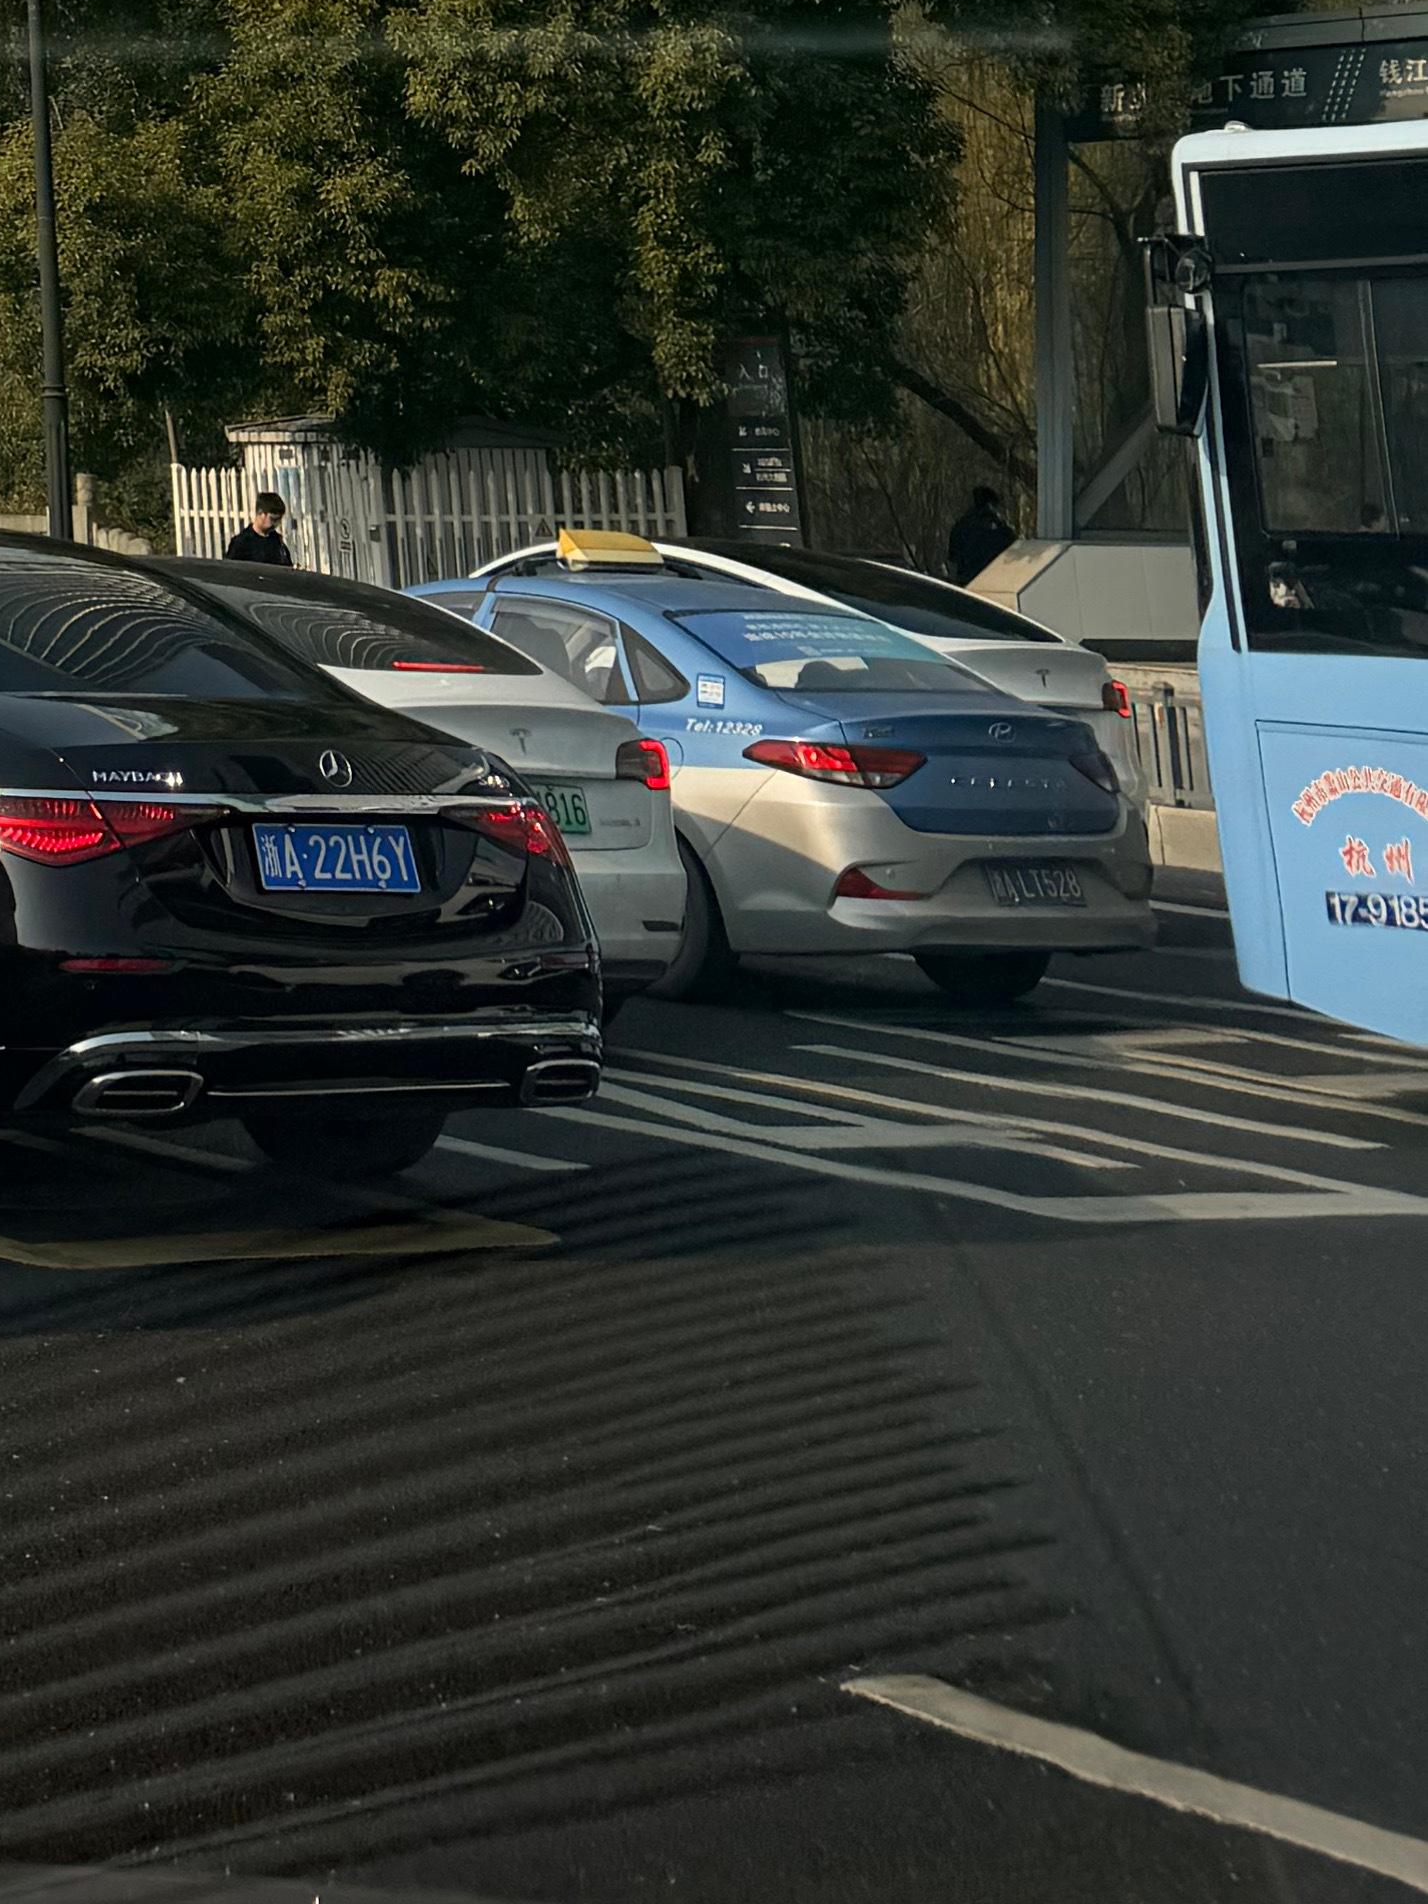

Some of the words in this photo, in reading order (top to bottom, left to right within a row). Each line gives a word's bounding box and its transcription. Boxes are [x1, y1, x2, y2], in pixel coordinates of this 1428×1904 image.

[685, 717, 764, 736] Tel:12328
[91, 769, 184, 788] MAYBACH
[1339, 834, 1415, 887] 杭州
